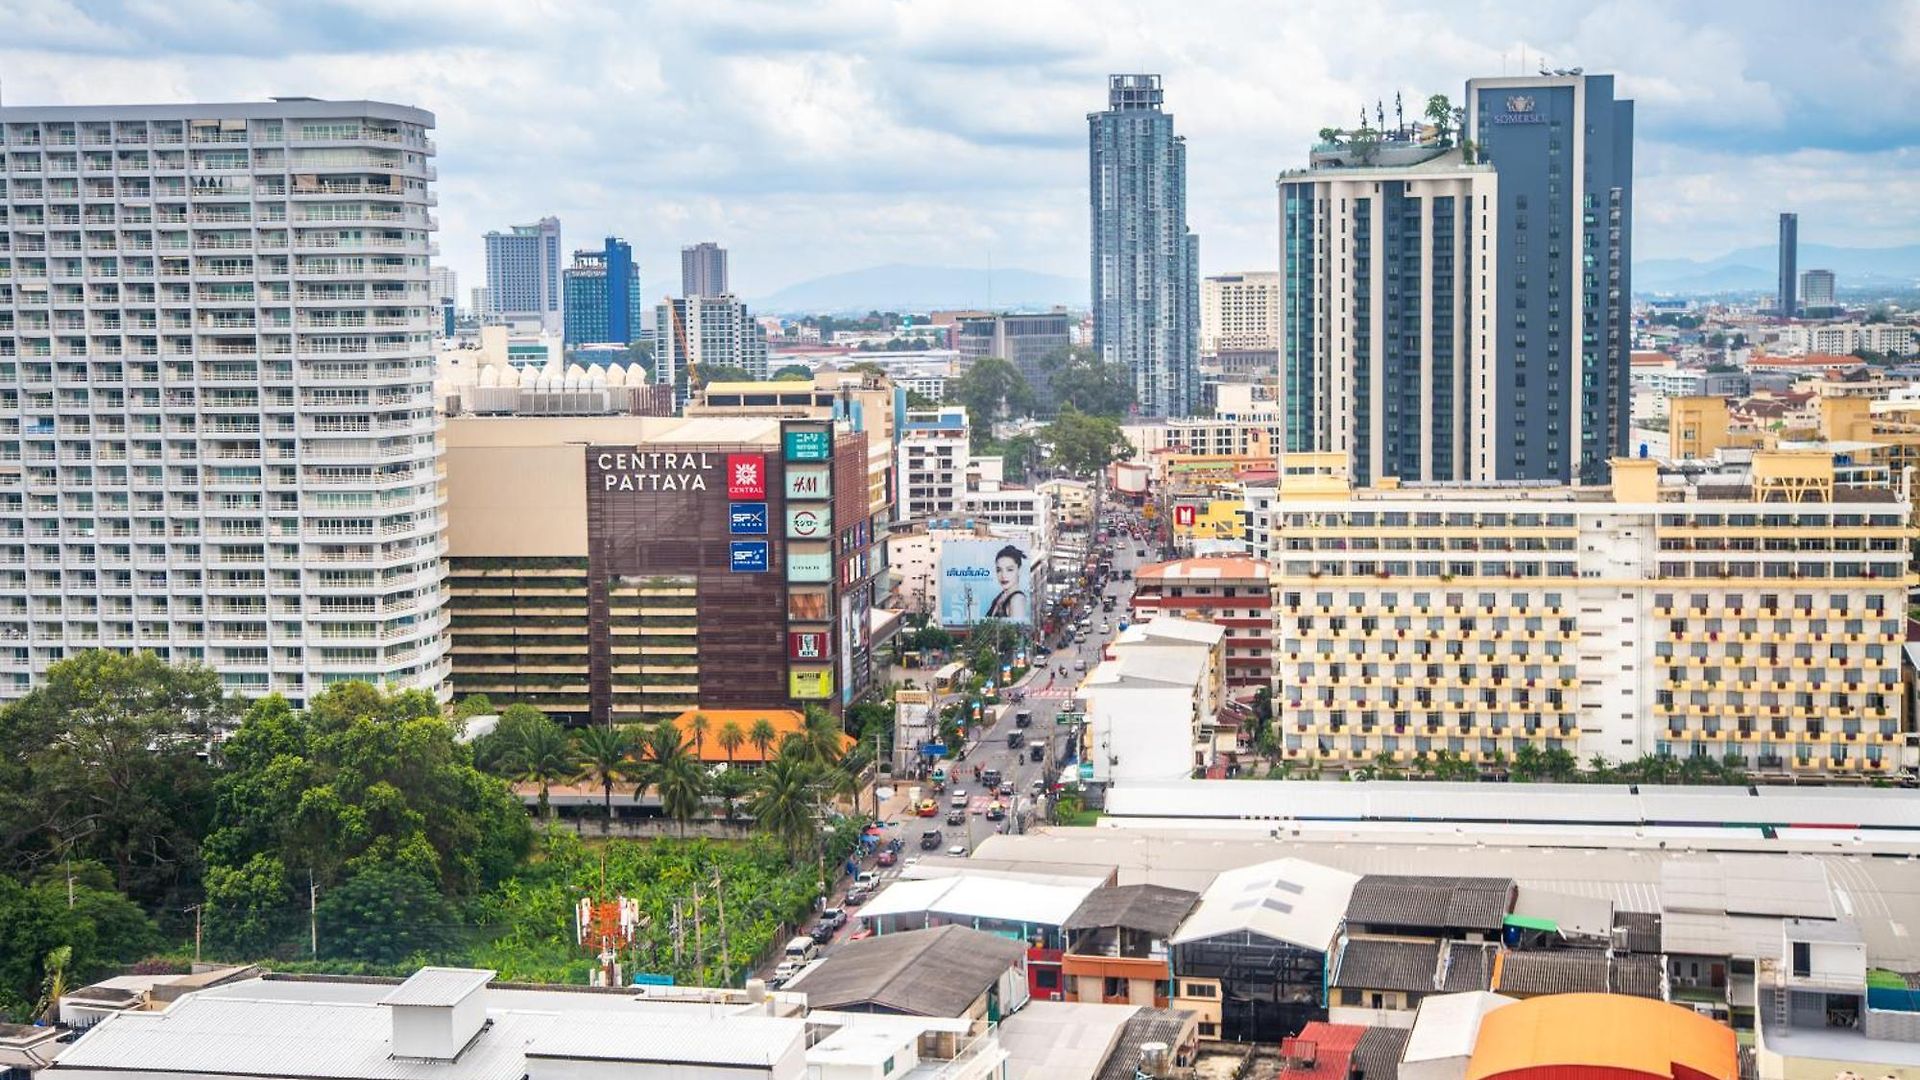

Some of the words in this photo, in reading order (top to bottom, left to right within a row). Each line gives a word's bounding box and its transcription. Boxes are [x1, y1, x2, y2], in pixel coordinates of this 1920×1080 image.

[1494, 114, 1545, 124] SOMERSET
[598, 453, 712, 470] CENTRAL
[605, 474, 706, 491] PATTAYA
